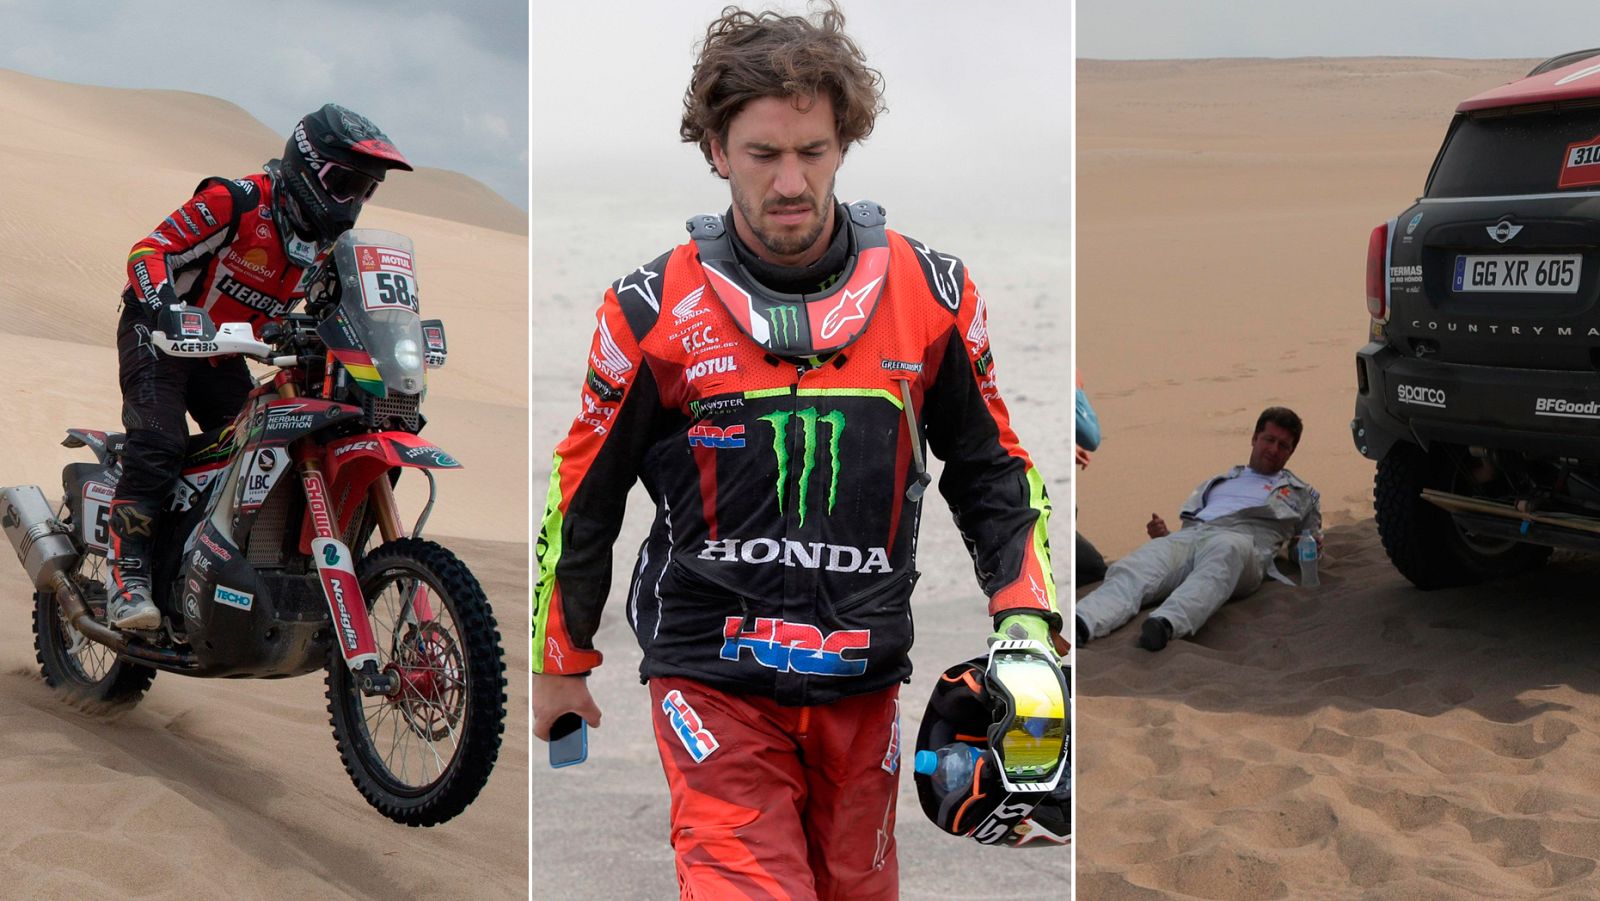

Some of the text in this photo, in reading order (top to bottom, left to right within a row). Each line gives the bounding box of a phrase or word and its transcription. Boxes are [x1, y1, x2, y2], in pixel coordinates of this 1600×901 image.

[195, 202, 217, 226] ACE
[228, 250, 276, 278] BancoSol
[381, 255, 411, 268] MOTUL
[1390, 265, 1423, 276] TERMAS
[1471, 260, 1575, 286] GG XR 605
[134, 261, 163, 310] HERBALIFE
[376, 273, 411, 306] 58
[675, 308, 711, 326] HONDA
[1412, 320, 1600, 336] COUNTRYMA
[590, 351, 628, 385] HONDA
[685, 355, 738, 383] MOTUL
[700, 398, 745, 410] MONSTER
[1397, 384, 1447, 404] sparco
[266, 422, 312, 431] NUTRITION
[268, 415, 314, 423] HERBALIFE
[688, 424, 746, 448] HRC
[249, 474, 270, 490] LBC
[697, 537, 894, 574] HONDA
[216, 589, 251, 606] TECHO
[330, 578, 359, 650] Nosiglia
[719, 616, 871, 676] HRC
[662, 690, 719, 763] HRC
